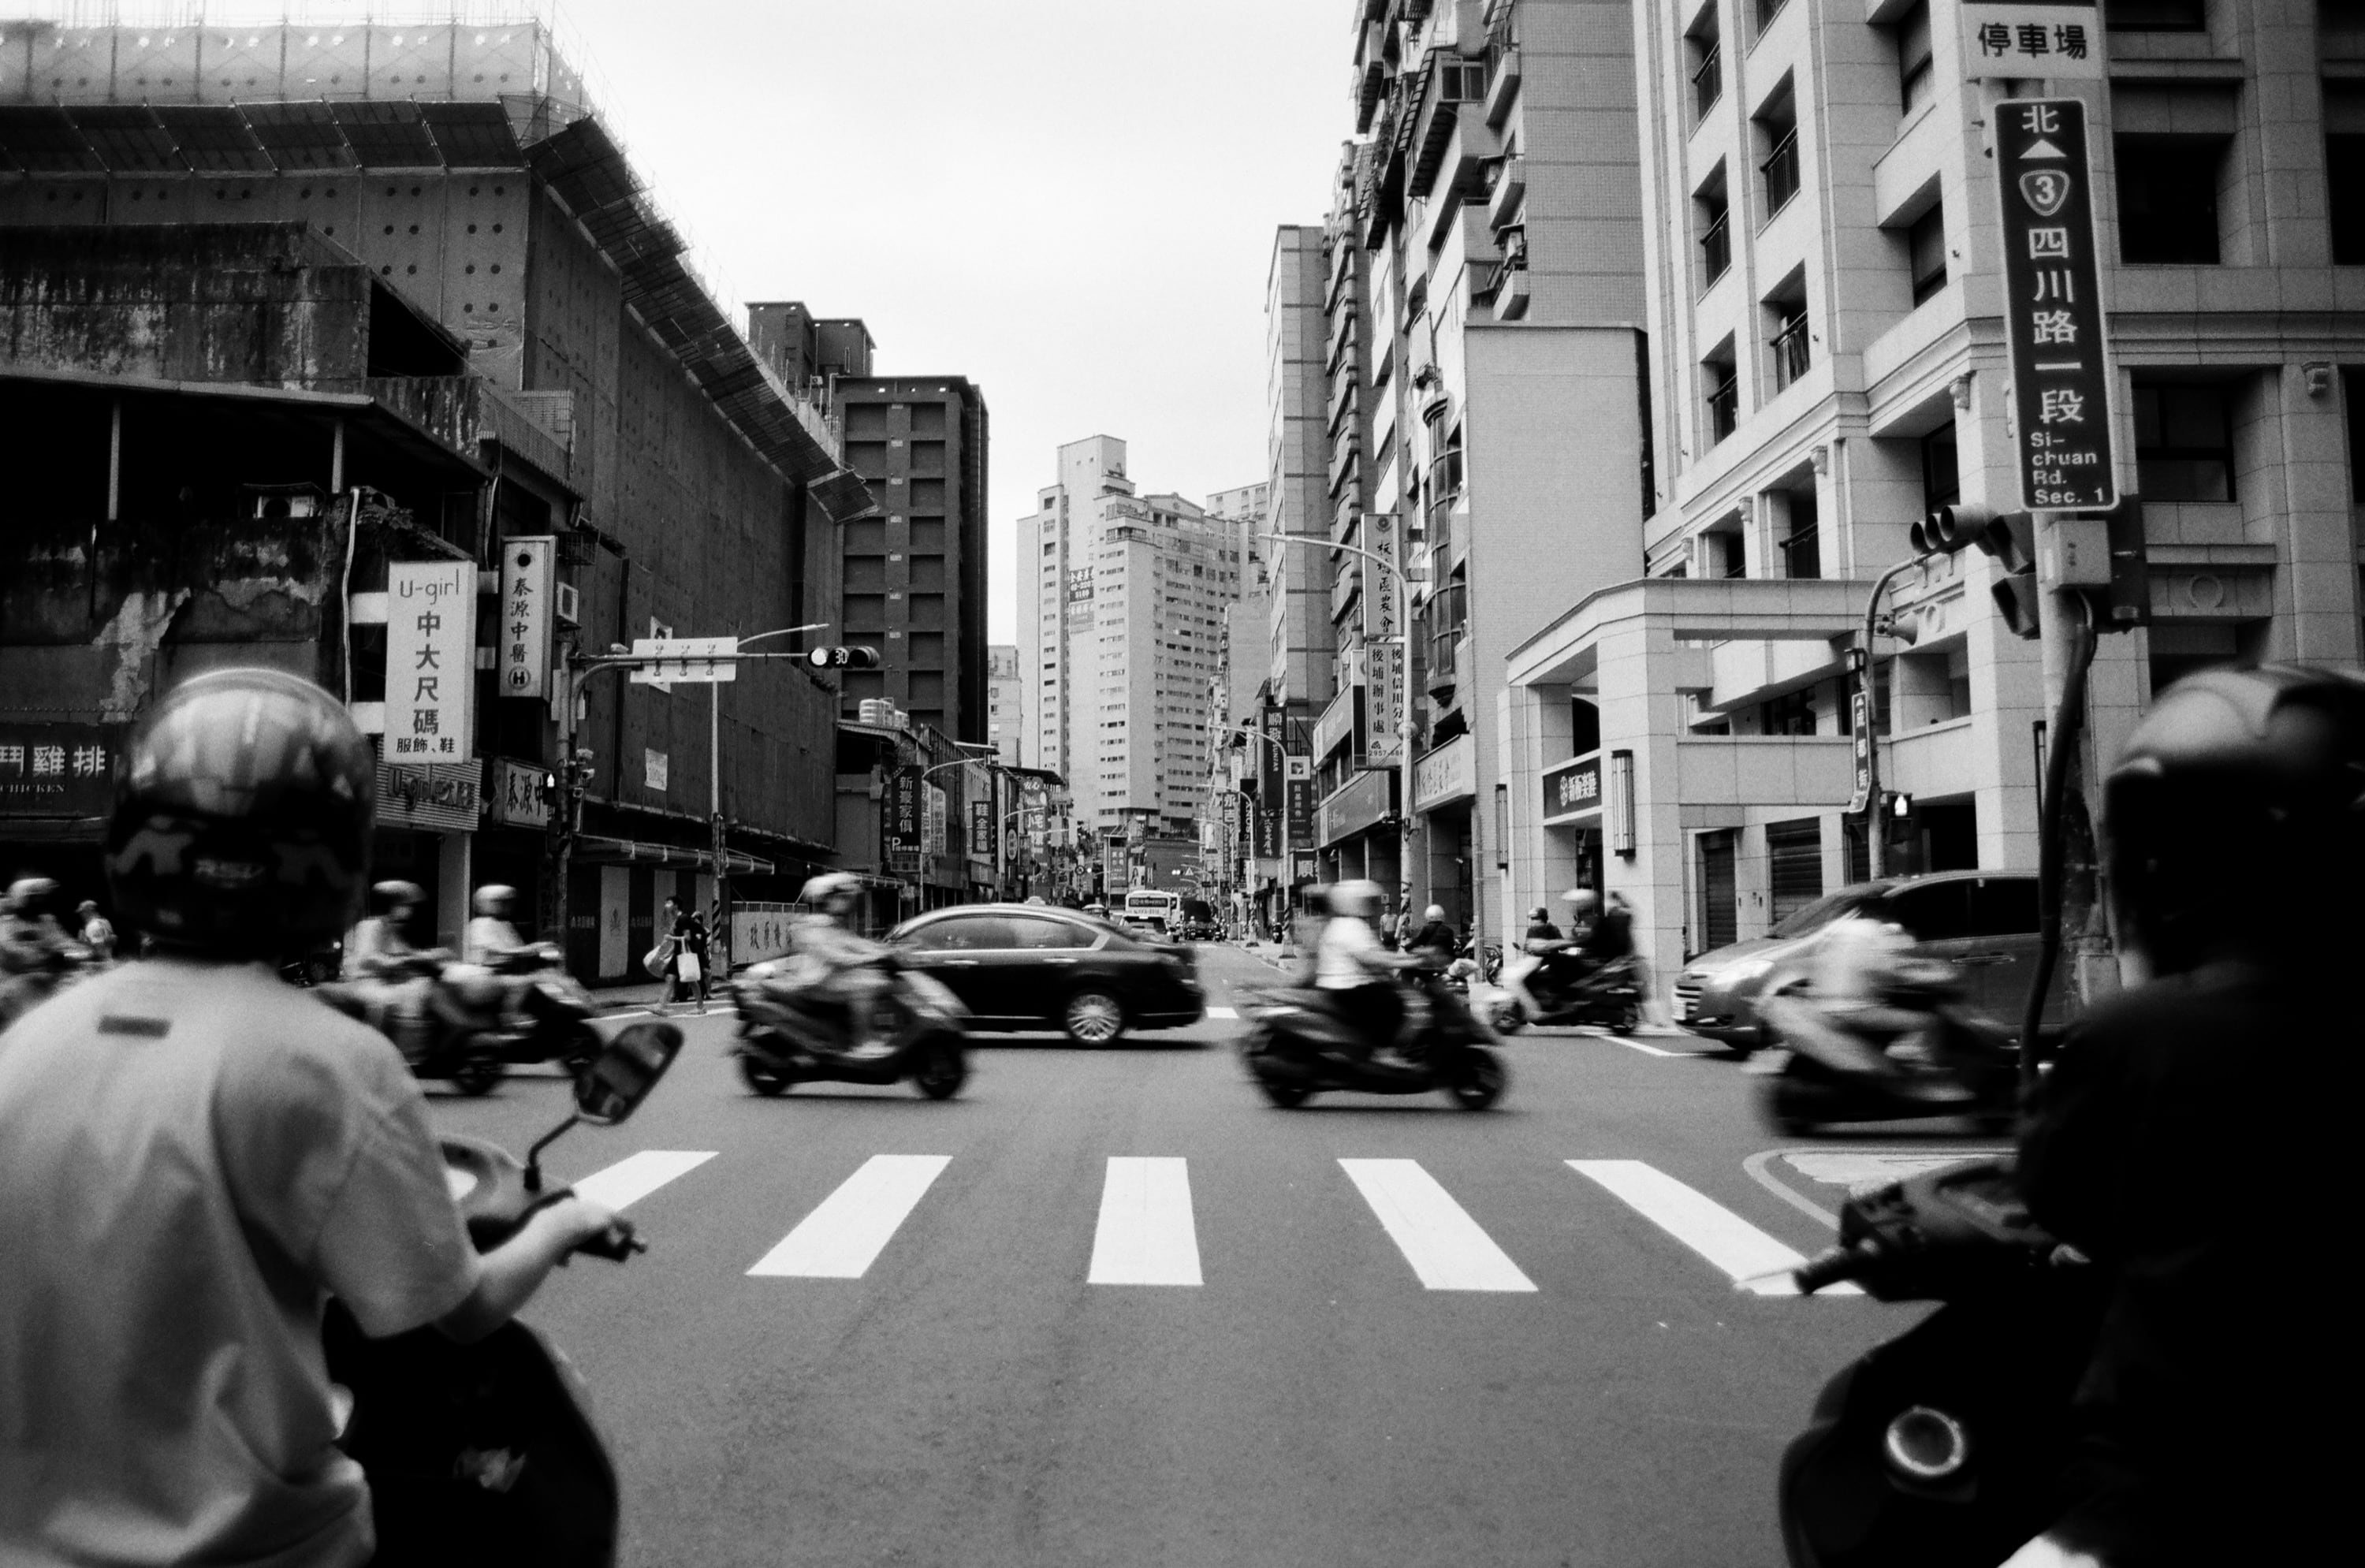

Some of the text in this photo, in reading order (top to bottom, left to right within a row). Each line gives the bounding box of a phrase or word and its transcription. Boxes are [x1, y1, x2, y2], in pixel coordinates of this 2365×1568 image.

[1978, 23, 2087, 59] 停車場
[2022, 105, 2060, 133] 北
[2035, 176, 2055, 204] 3
[2028, 228, 2084, 423] 四川路一段
[2030, 432, 2065, 447] Si-
[2032, 451, 2098, 466] chuan
[2033, 470, 2068, 485] Rd.
[2035, 487, 2103, 505] Sec. 1
[400, 568, 460, 605] U-girl
[510, 577, 534, 663] 泰源中醫
[835, 650, 848, 665] 30
[412, 610, 441, 735] 中大尺碼
[397, 738, 455, 754] 服飾、鞋
